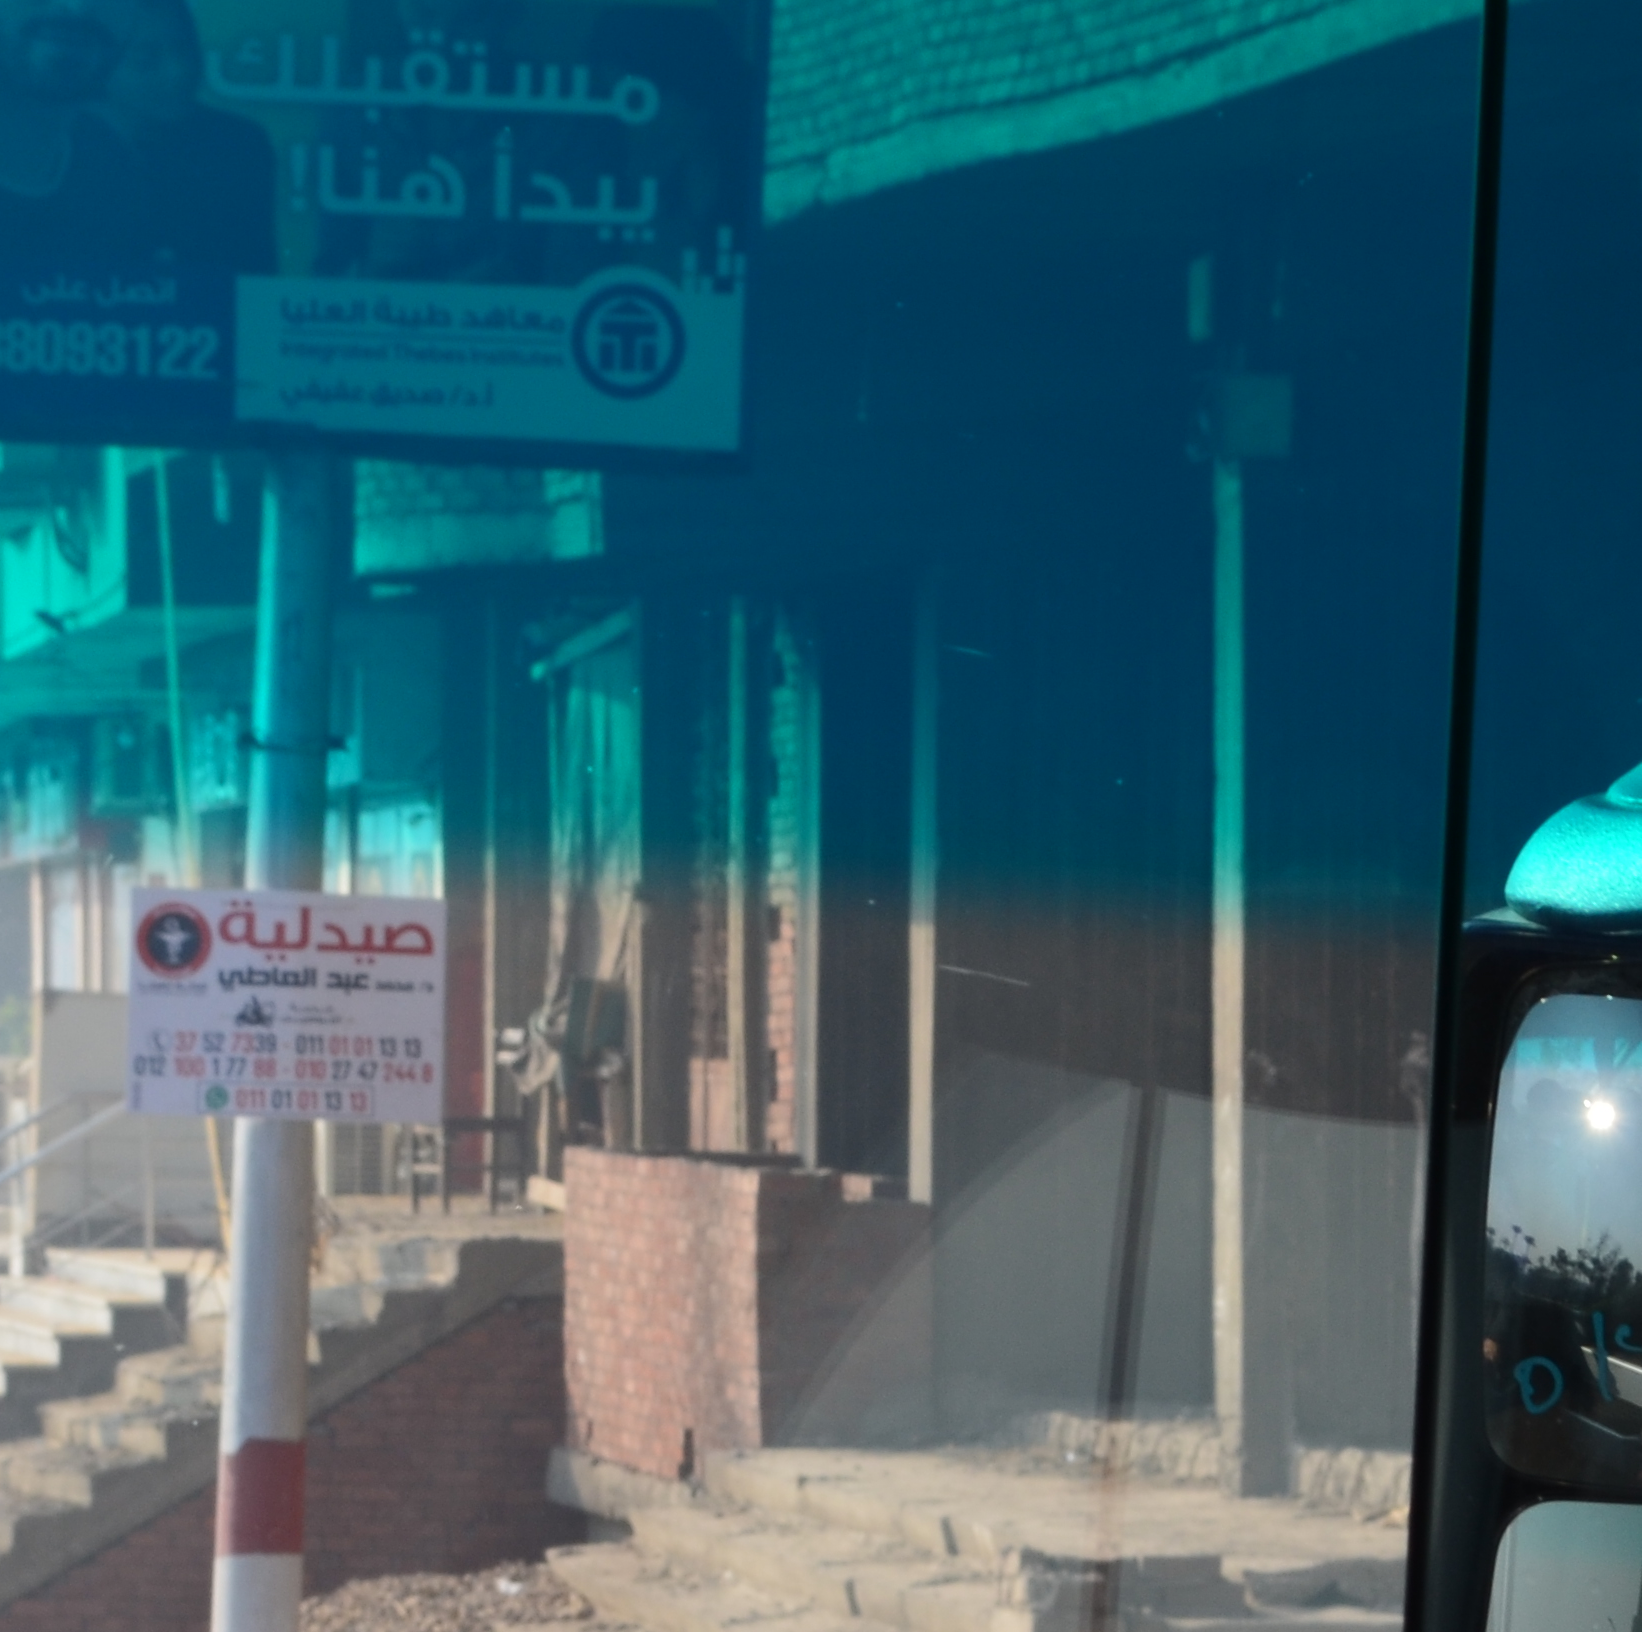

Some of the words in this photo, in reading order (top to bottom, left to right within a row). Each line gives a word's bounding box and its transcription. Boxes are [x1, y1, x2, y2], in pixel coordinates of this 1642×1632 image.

[204, 28, 661, 125] مستقبلك
[493, 128, 658, 242] يبدأ
[280, 296, 368, 326] العليا
[460, 305, 567, 334] معاهد
[218, 899, 434, 964] صيدلية
[295, 1033, 325, 1054] 011
[328, 1034, 349, 1055] 01
[352, 1035, 373, 1055] 01
[234, 1088, 266, 1109] 011
[271, 1089, 293, 1110] 01
[297, 1090, 319, 1110] 01
